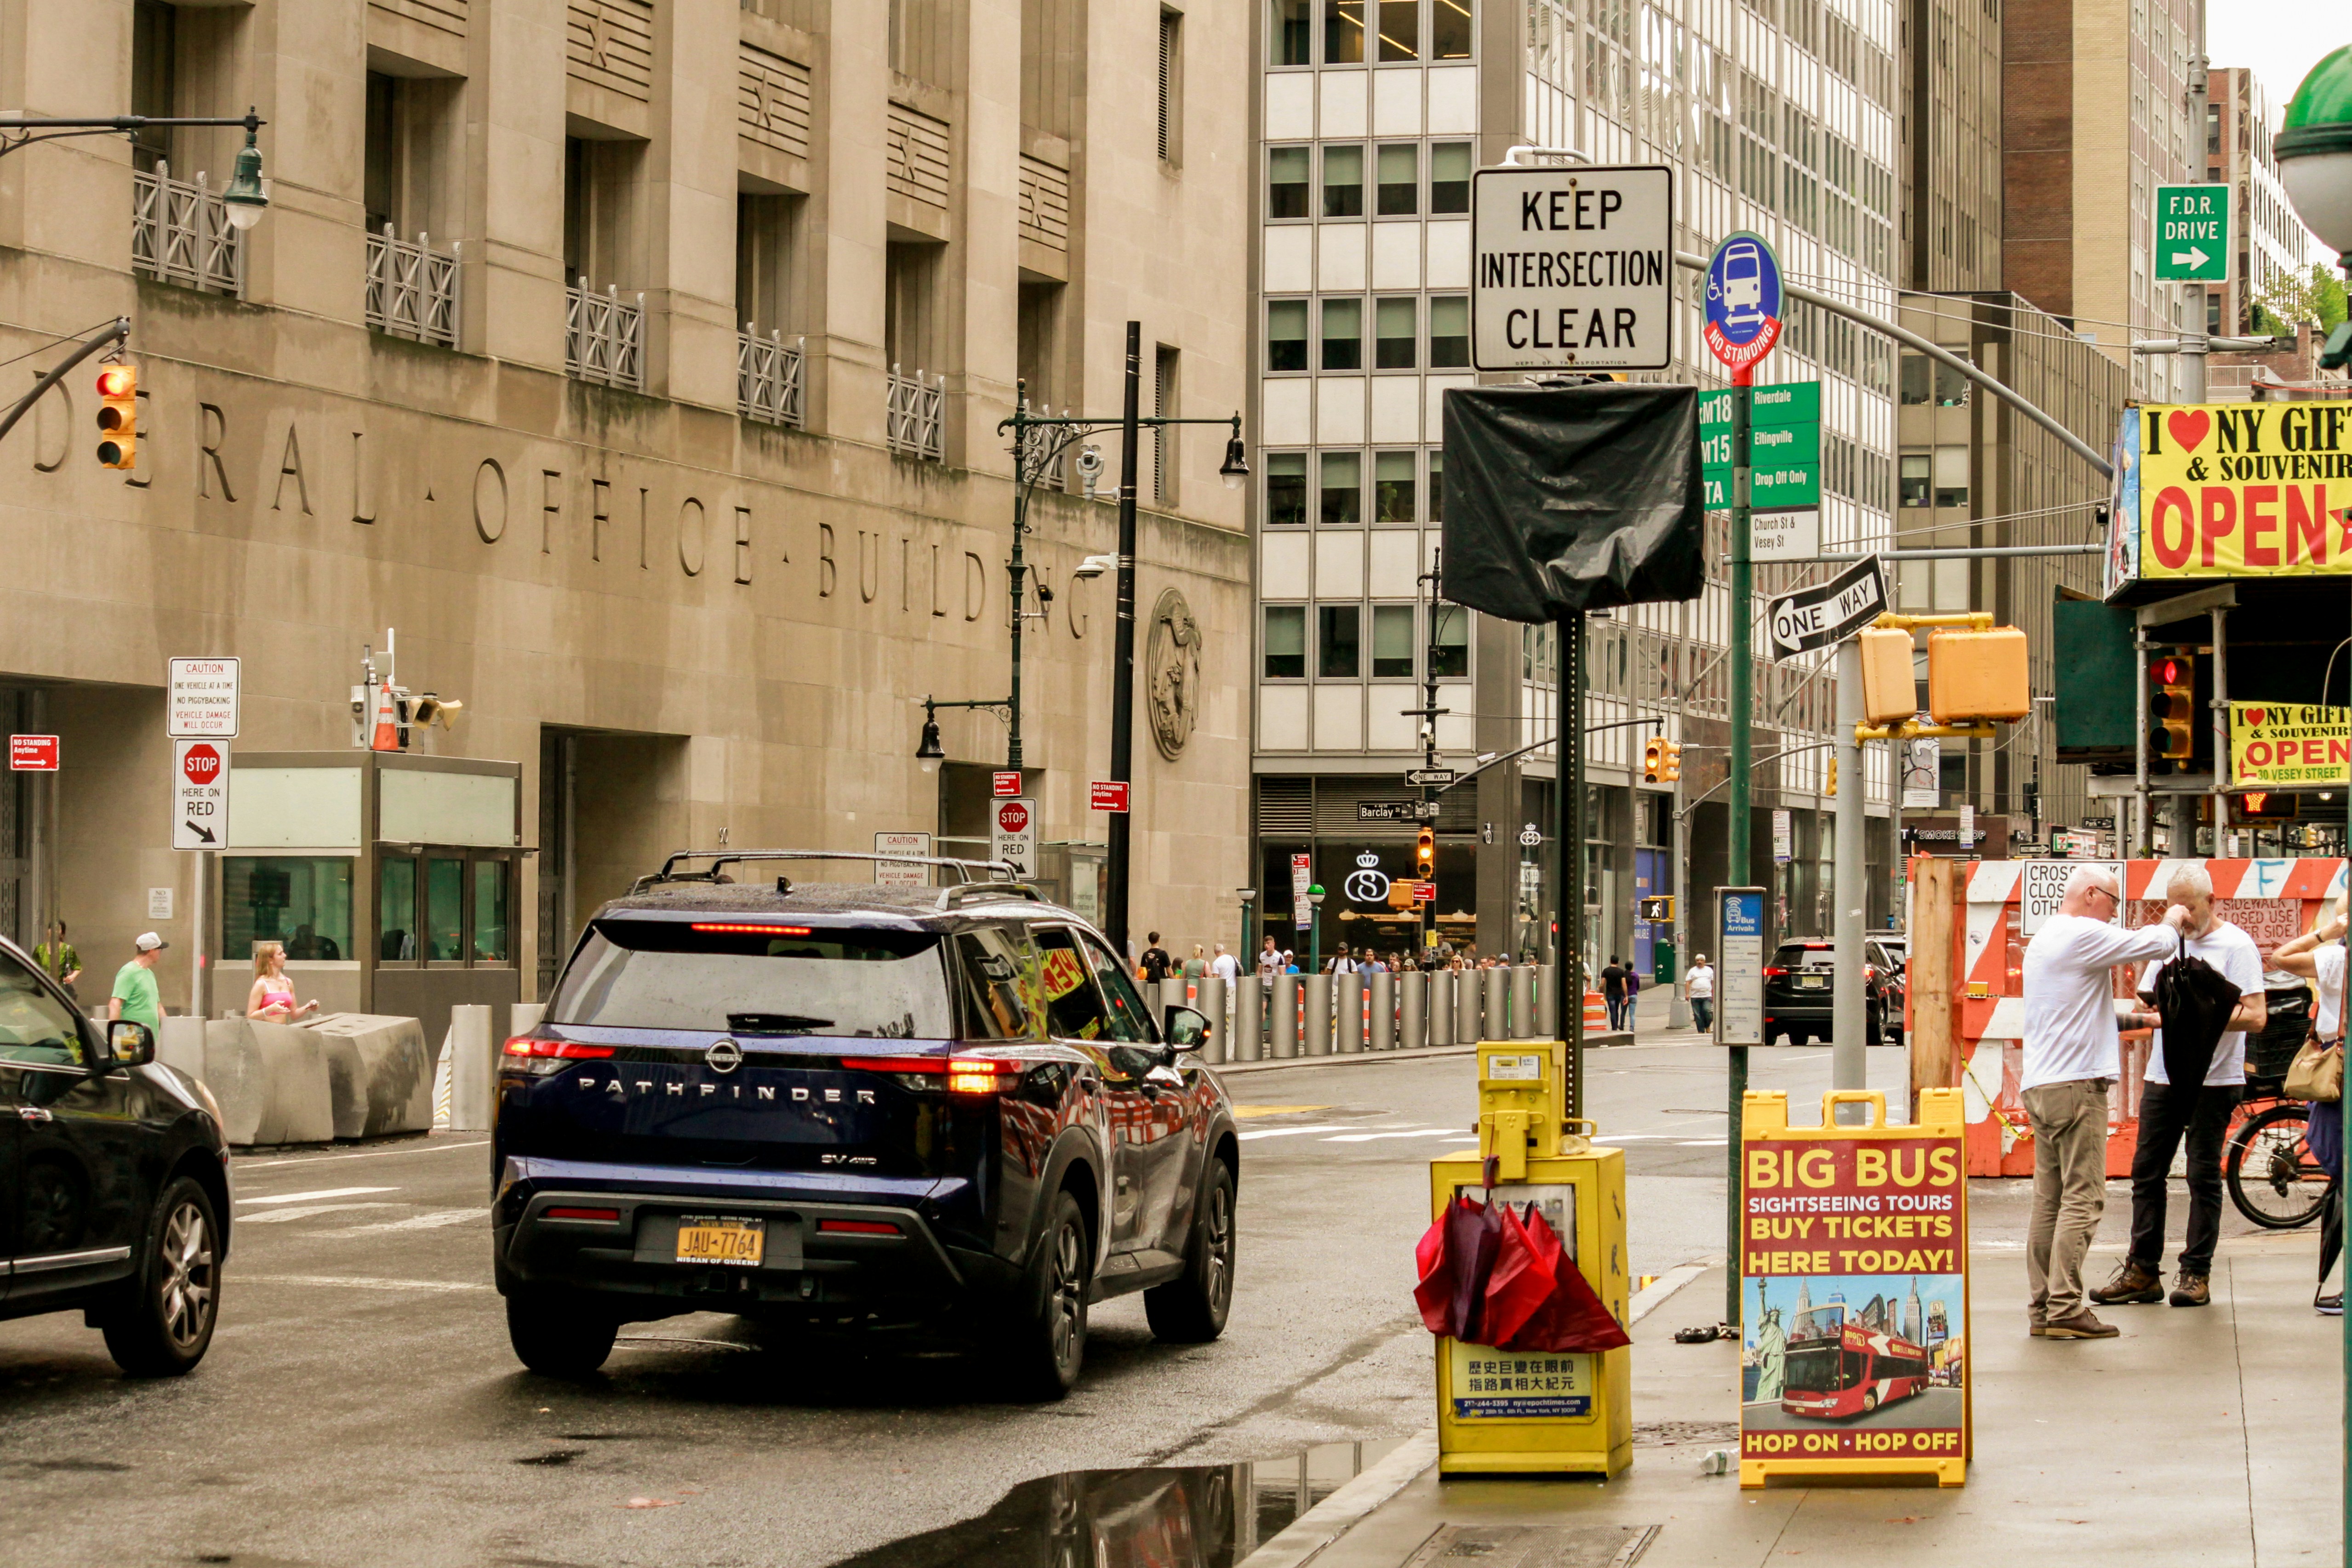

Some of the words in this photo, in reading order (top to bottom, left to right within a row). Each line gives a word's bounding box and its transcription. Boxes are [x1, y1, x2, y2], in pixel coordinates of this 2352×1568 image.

[1523, 190, 1622, 232] KEEP
[2170, 196, 2215, 215] F.D.R.
[2165, 221, 2219, 240] DRIVE
[1481, 250, 1663, 289] INTERSECTION
[1506, 308, 1637, 350] CLEAR
[1709, 329, 1724, 351] NO
[1724, 324, 1774, 362] STANDING
[1754, 389, 1791, 405] Riverdale
[1754, 430, 1793, 447] Eltingville
[2147, 411, 2162, 455] I
[2216, 409, 2265, 454] NY
[2280, 406, 2352, 452] GIF
[2186, 456, 2209, 481] &
[1755, 472, 1774, 488] Drop
[1775, 471, 1787, 484] Off
[1789, 470, 1807, 485] Only
[1754, 518, 1778, 531] Church
[1781, 517, 1788, 529] St
[1790, 516, 1795, 528] &
[2151, 484, 2327, 569] OPEN
[473, 458, 753, 586] OFFICE
[819, 522, 1089, 639] BUILDING
[1754, 536, 1775, 550] Vesey
[1777, 535, 1784, 547] St
[1778, 606, 1825, 639] ONE
[1839, 579, 1869, 618] WAY
[186, 663, 224, 673] CAUTION
[188, 696, 231, 705] PIGGYBACKING
[2237, 709, 2245, 726] I
[2266, 707, 2292, 726] NY
[2300, 706, 2351, 725] GIFT
[2250, 729, 2264, 739] &
[2270, 726, 2352, 739] SOUVENIR
[2246, 739, 2351, 766] OPEN
[187, 757, 217, 772] STOP
[2258, 769, 2268, 780] 30
[2272, 768, 2302, 780] VESEY
[2305, 767, 2342, 779] STREET
[183, 788, 204, 797] HERE
[209, 788, 220, 797] ON
[187, 802, 214, 816] RED
[1001, 812, 1026, 823] STOP
[1361, 807, 1393, 818] Barclay
[1919, 830, 1956, 840] SMOKE
[1002, 844, 1024, 855] RED
[2255, 861, 2285, 896] F
[2223, 899, 2286, 911] SIDEWALK
[2269, 909, 2294, 923] USE
[2265, 924, 2292, 938] SIDE
[579, 1078, 875, 1105] PATHFINDER
[822, 1155, 847, 1164] SV
[1749, 1149, 1835, 1189] BIG
[1856, 1147, 1957, 1187] BUS
[1749, 1196, 1880, 1213] SIGHTSEEING
[1885, 1195, 1952, 1211] TOURS
[1751, 1217, 1815, 1240] BUY
[1823, 1215, 1953, 1238] TICKETS
[684, 1231, 711, 1253] JAU
[721, 1232, 755, 1255] 7764
[1749, 1250, 1831, 1274] HERE
[1839, 1249, 1954, 1272] TODAY!
[1845, 1330, 1857, 1339] BIG
[1469, 1359, 1574, 1374] 歷史巨變在眼前
[1747, 1434, 1798, 1453] HOP
[1803, 1434, 1838, 1452] ON
[1855, 1433, 1907, 1452] HOP
[1912, 1432, 1958, 1451] OFF
